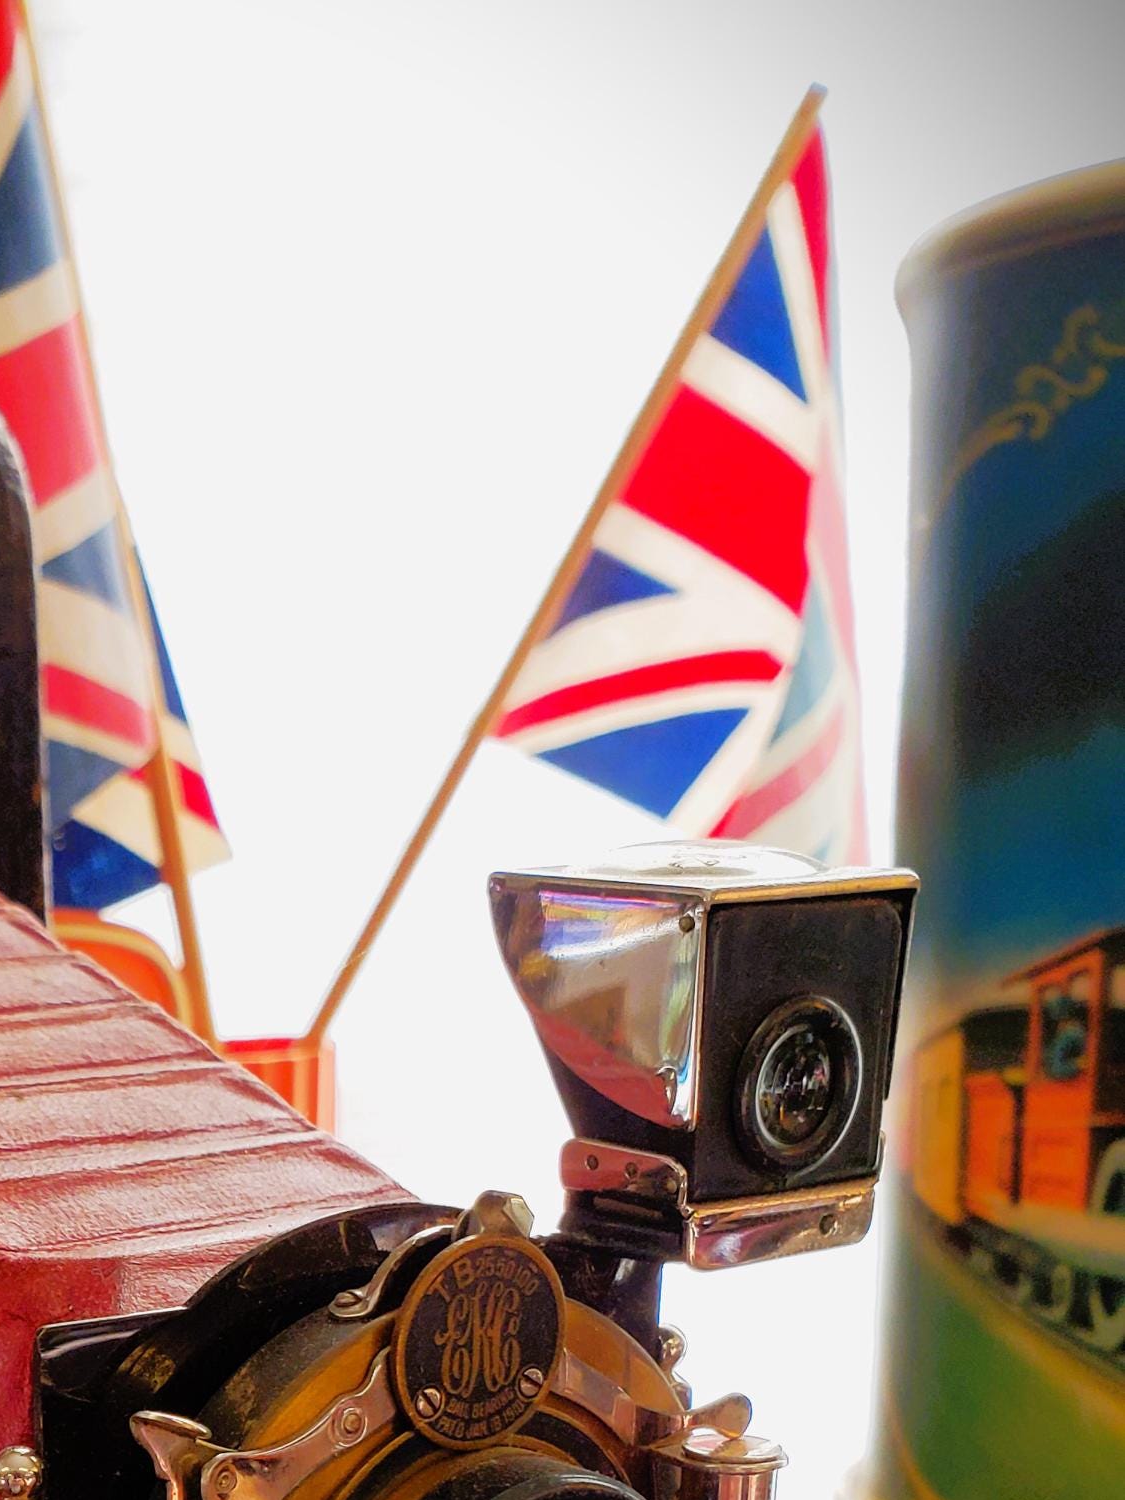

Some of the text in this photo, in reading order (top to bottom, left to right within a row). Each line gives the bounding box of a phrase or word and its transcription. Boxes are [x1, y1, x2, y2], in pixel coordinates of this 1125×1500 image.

[426, 1257, 540, 1302] T B 25 50 100
